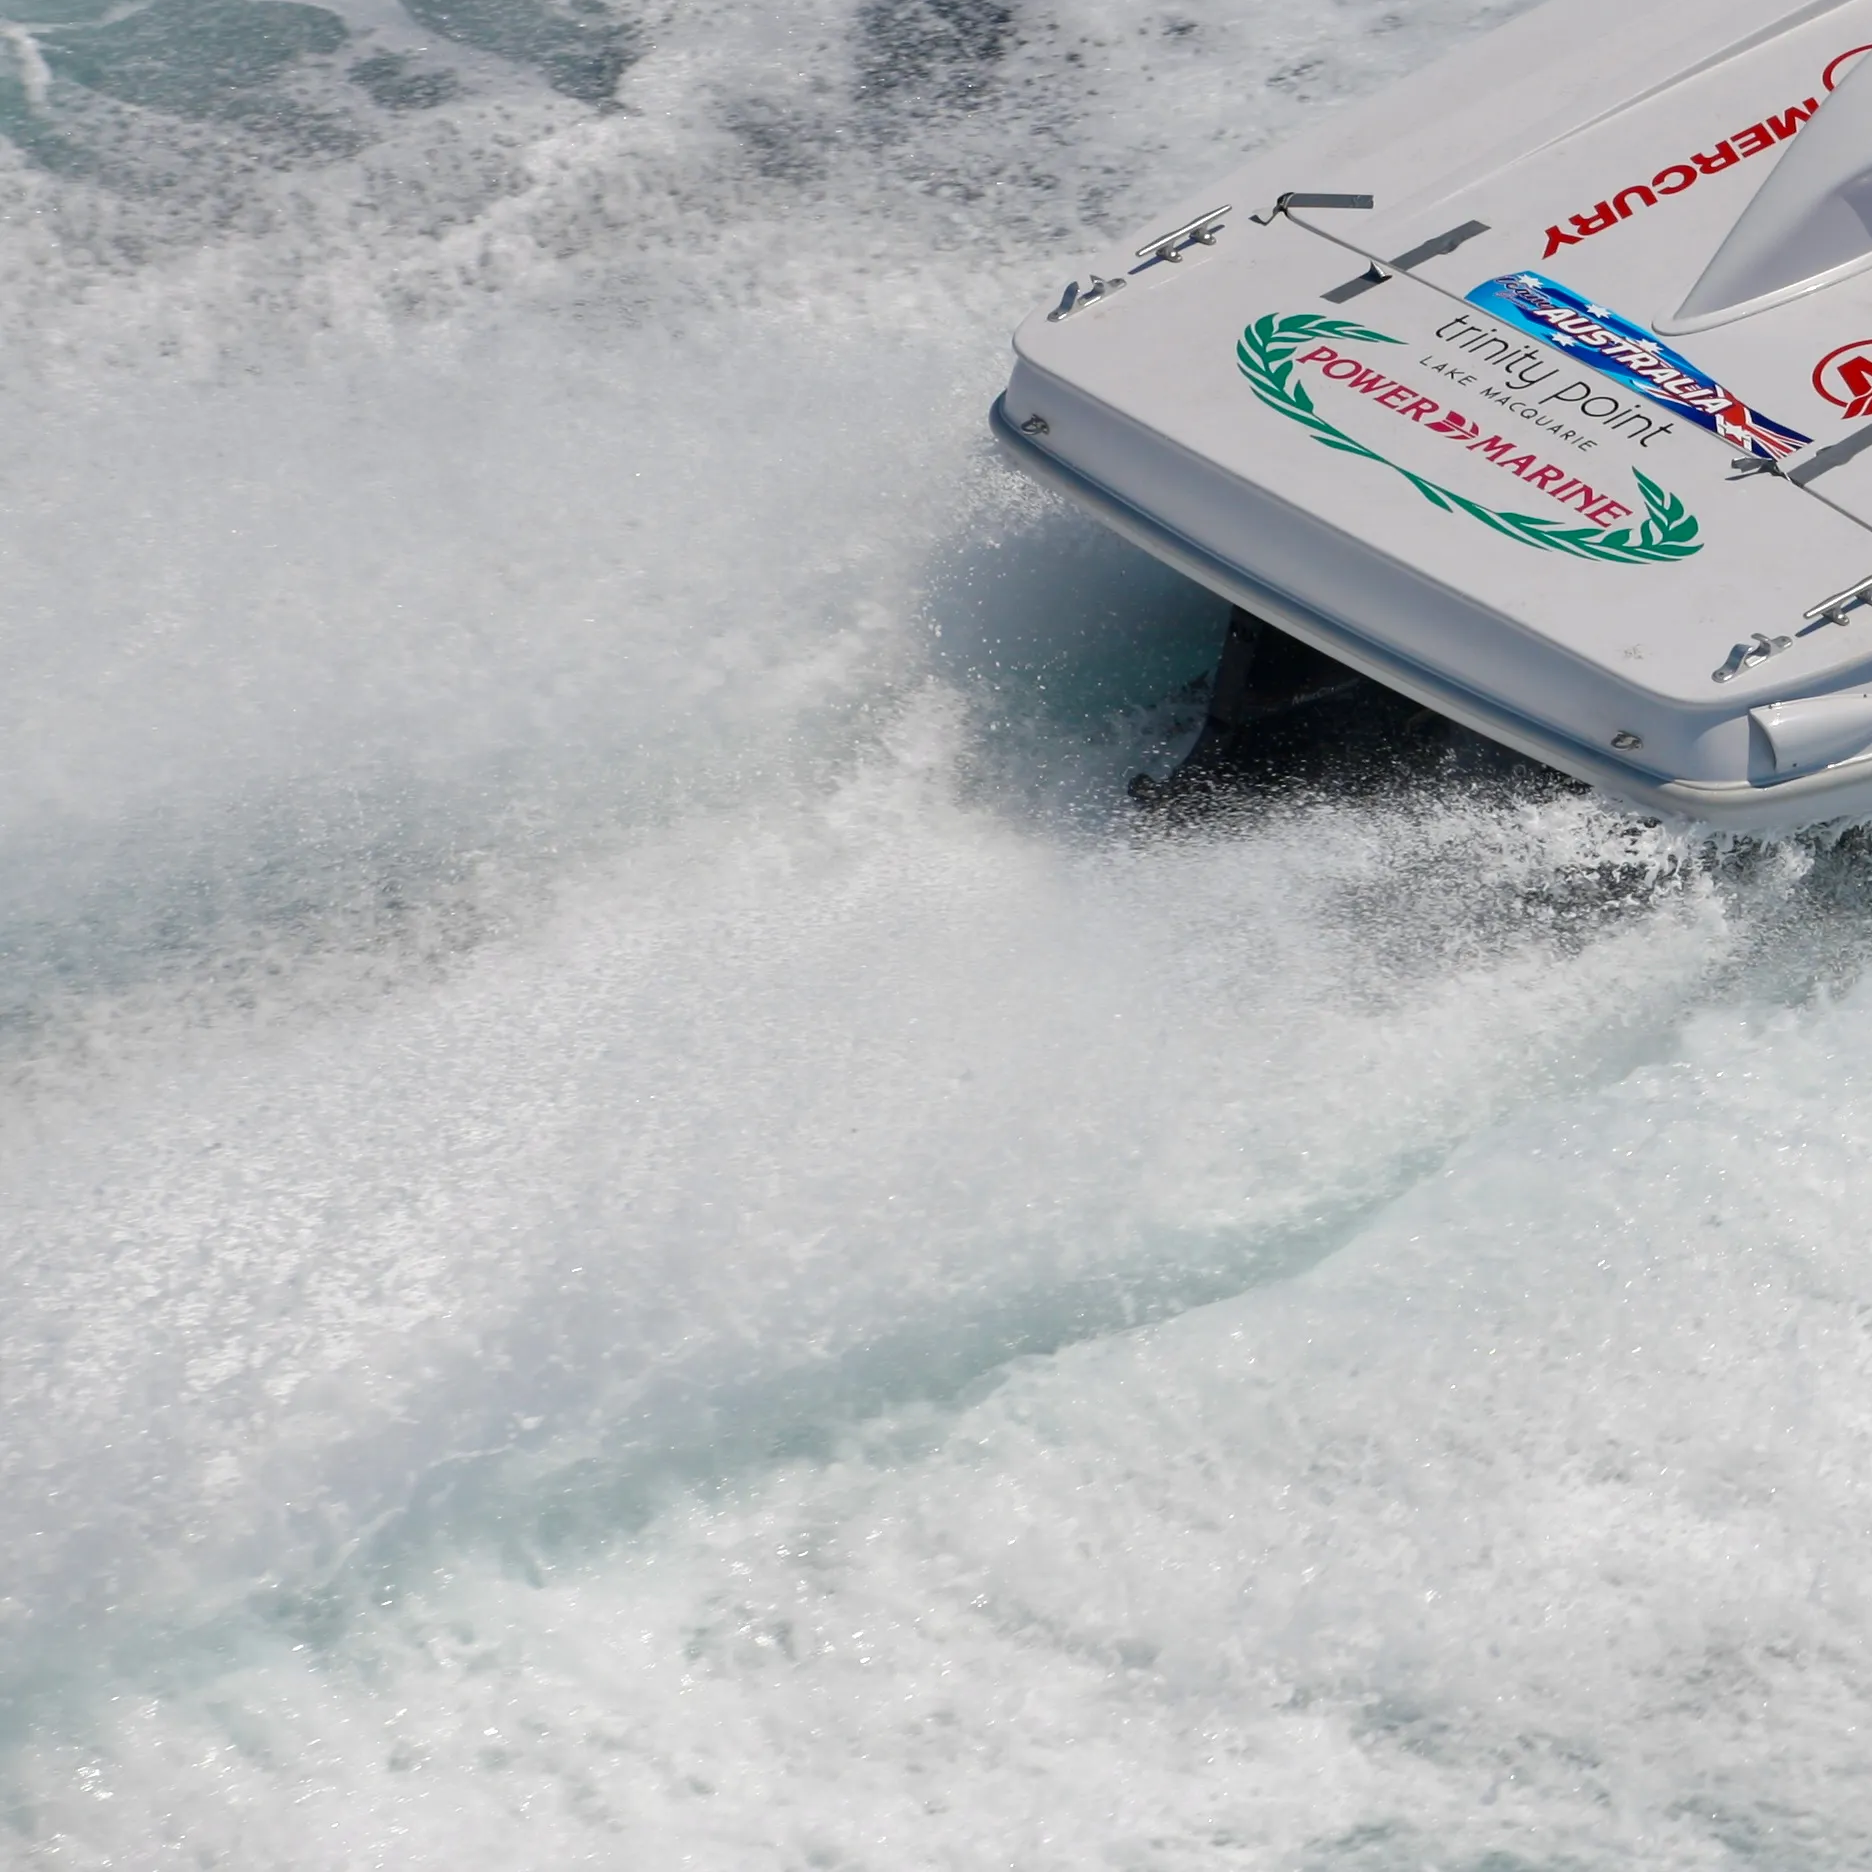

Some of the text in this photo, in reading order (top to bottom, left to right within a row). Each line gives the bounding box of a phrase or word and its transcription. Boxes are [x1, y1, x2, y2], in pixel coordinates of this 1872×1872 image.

[1541, 96, 1820, 260] MERCURY
[1419, 356, 1599, 453] LAKE MACQUARIE
[1434, 314, 1675, 448] trinity point
[1533, 306, 1735, 415] AUSTRALIA
[1296, 345, 1634, 529] POWER MARINE
